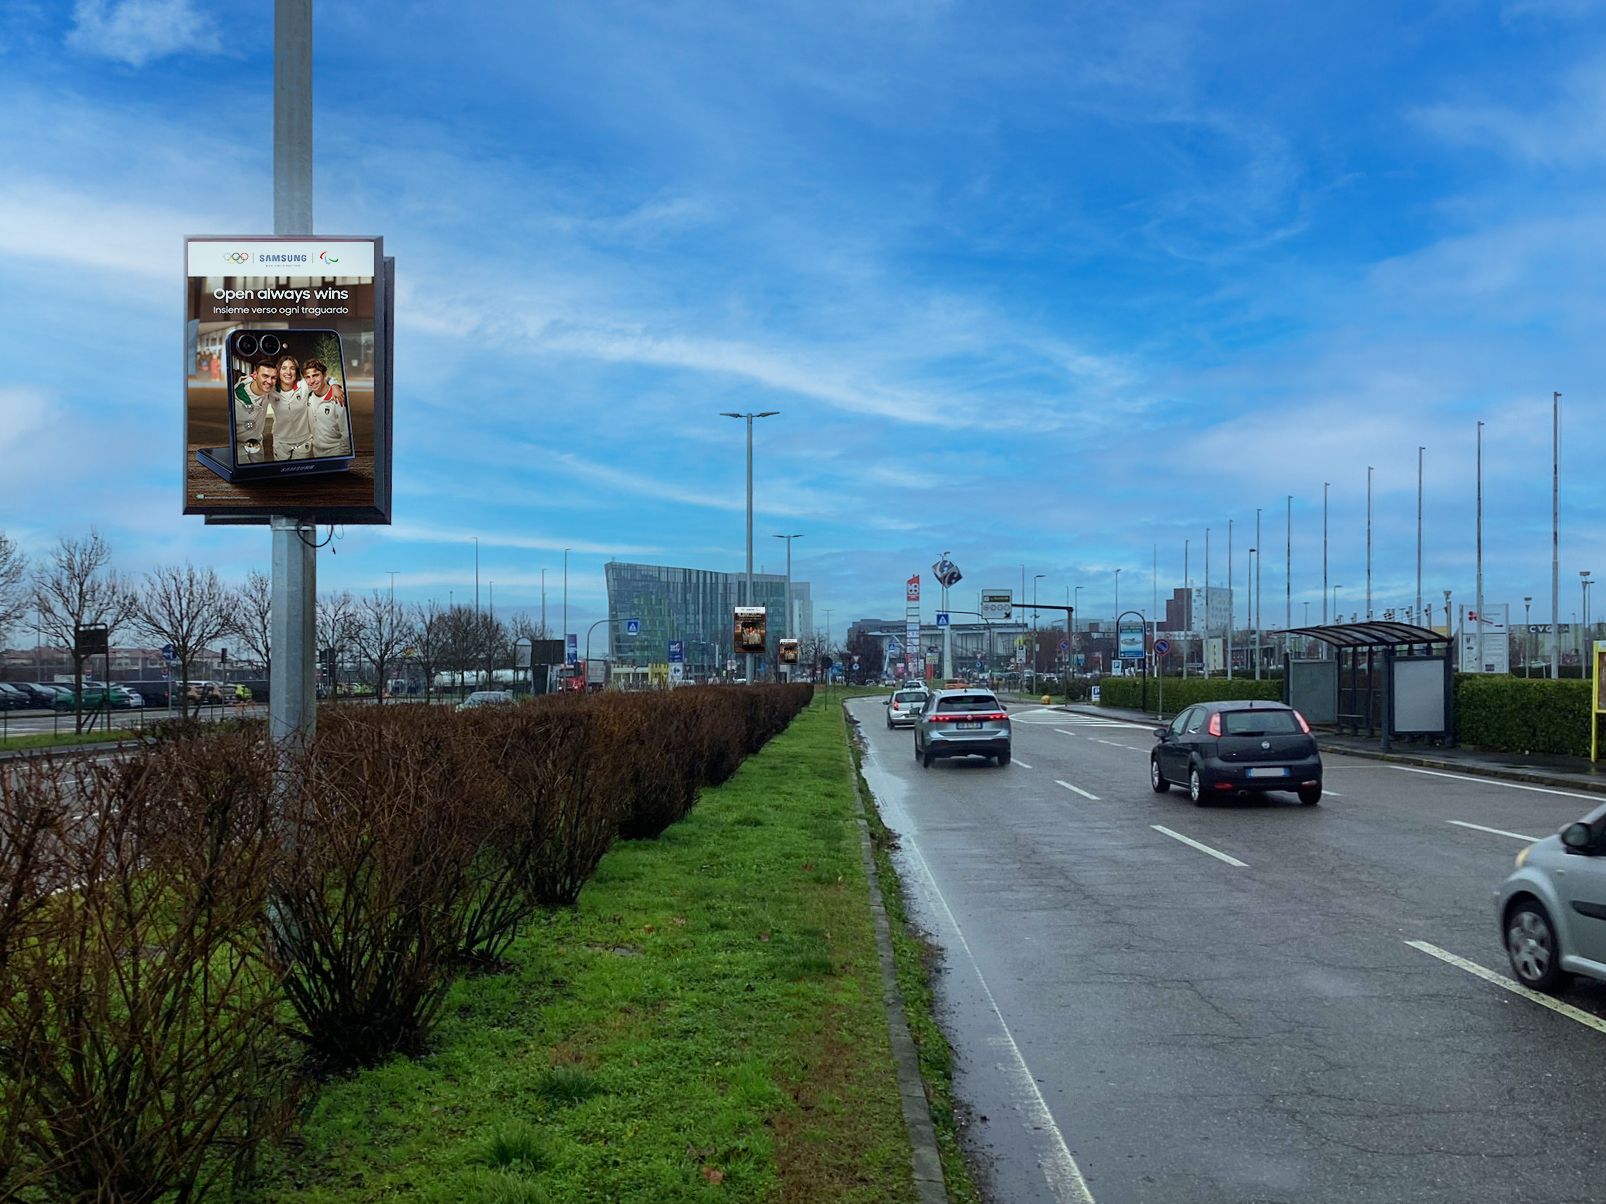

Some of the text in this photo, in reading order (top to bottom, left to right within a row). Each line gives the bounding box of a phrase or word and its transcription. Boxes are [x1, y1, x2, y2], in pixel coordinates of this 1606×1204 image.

[259, 254, 307, 262] SAMSUNG
[213, 287, 349, 303] Open always wins
[213, 306, 250, 314] Insieme
[279, 306, 300, 316] ogni
[301, 306, 349, 316] traguardo
